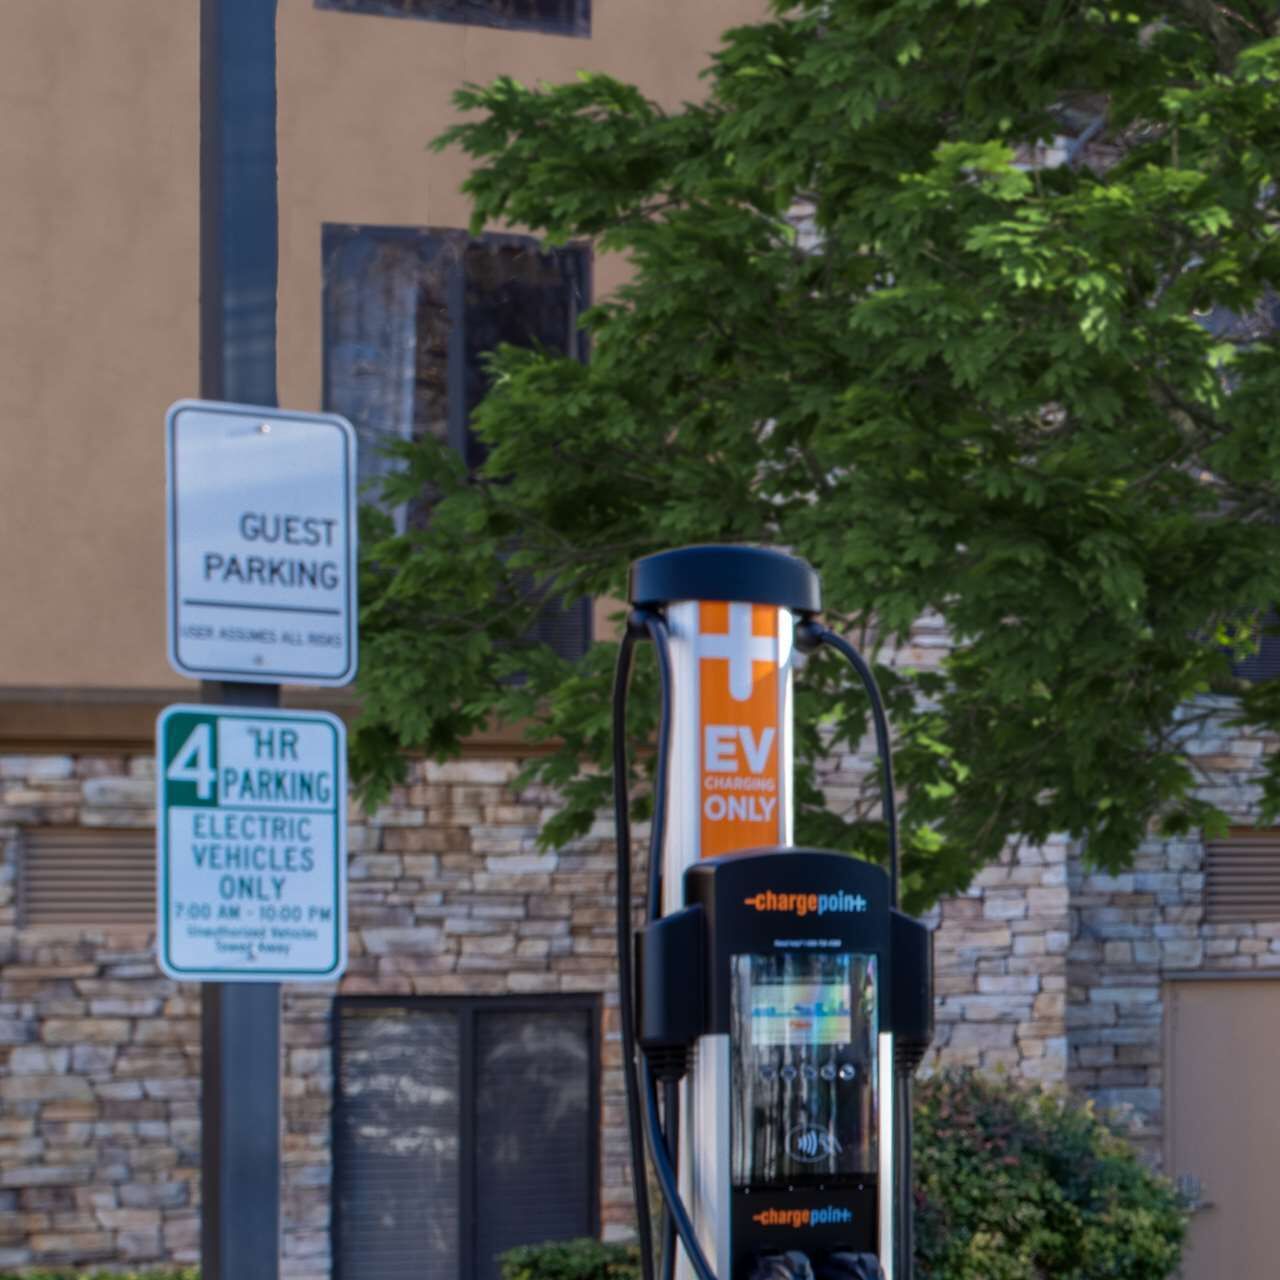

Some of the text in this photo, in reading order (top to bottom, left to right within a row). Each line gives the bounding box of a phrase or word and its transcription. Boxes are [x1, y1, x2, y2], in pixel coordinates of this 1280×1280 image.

[239, 511, 337, 547] GUEST
[203, 552, 339, 591] PARKING
[167, 722, 299, 800] 4 HR
[704, 724, 776, 774] EV
[222, 767, 331, 804] PARKING
[704, 776, 777, 792] CHARGING
[703, 794, 777, 822] ONLY
[192, 812, 312, 842] ELECTRIC
[191, 843, 315, 872] VEHICLES
[218, 874, 286, 901] ONLY
[218, 904, 241, 919] AM
[308, 906, 332, 922] PM
